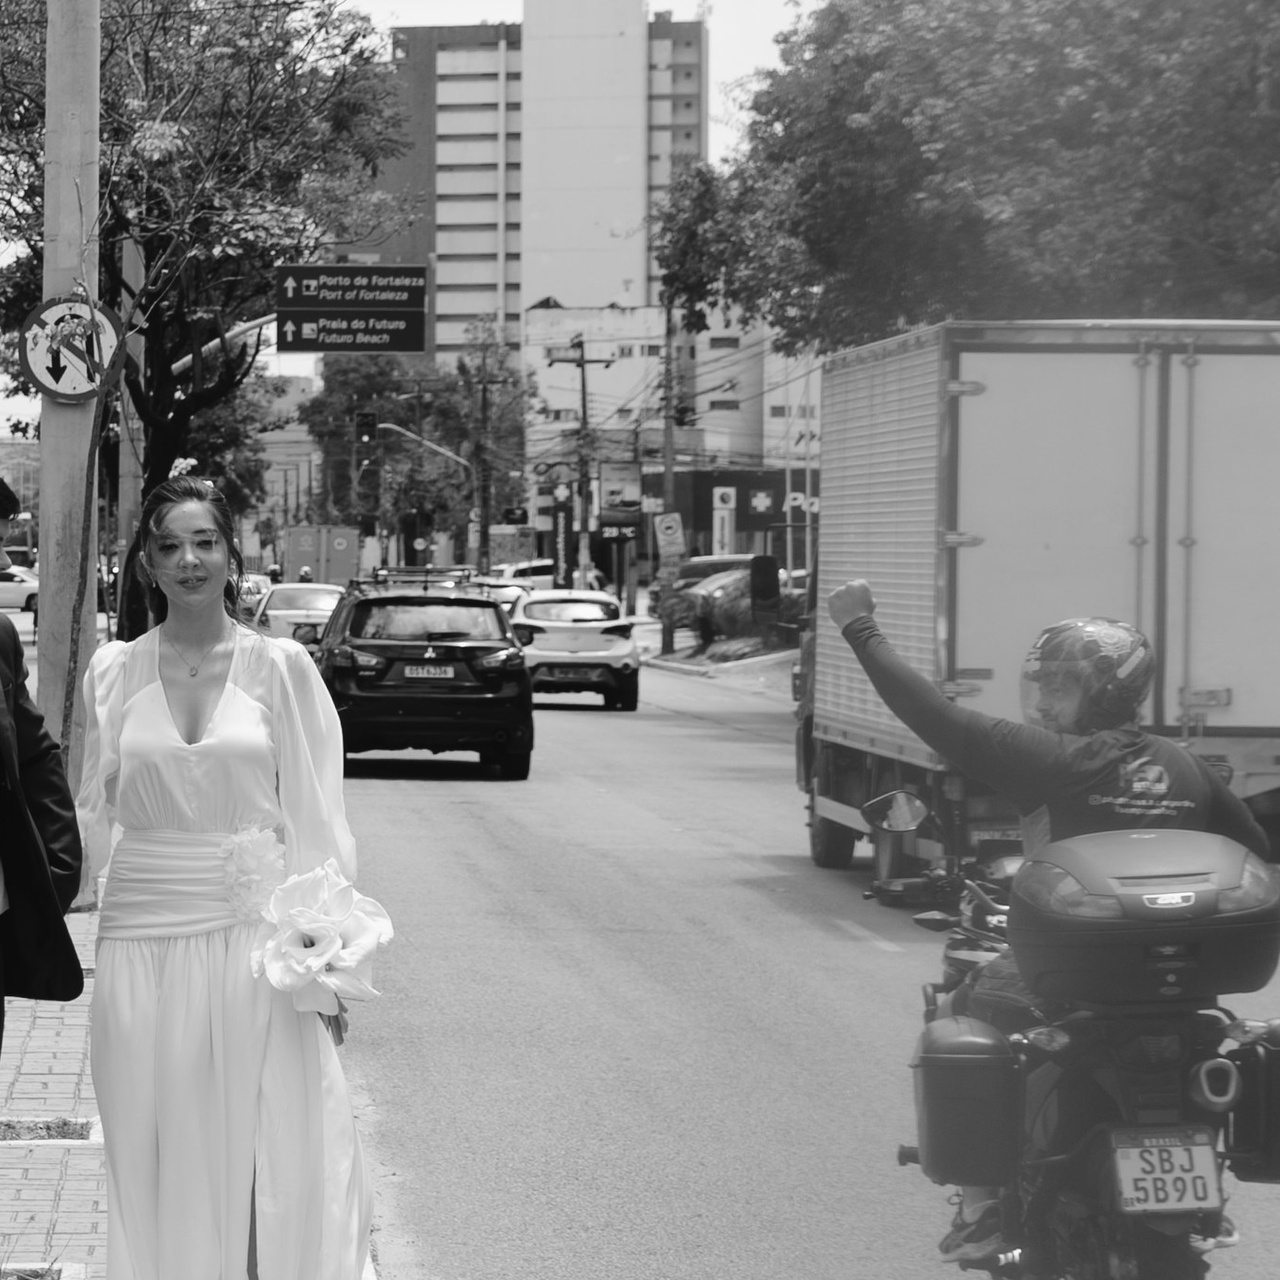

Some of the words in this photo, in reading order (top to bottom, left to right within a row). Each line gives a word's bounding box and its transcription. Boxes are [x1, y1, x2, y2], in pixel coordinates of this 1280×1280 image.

[319, 275, 351, 286] Porto
[353, 275, 369, 286] de
[371, 275, 425, 287] Fortaleza
[319, 289, 343, 300] Port
[344, 289, 357, 300] of
[358, 289, 409, 301] Fortaleza
[319, 318, 348, 329] Praia
[350, 318, 366, 329] do
[369, 318, 407, 330] Futuro
[318, 332, 354, 344] Futuro
[355, 332, 390, 344] Beach
[1143, 1137, 1182, 1147] BRASIL
[1139, 1147, 1194, 1175] SBJ
[1132, 1175, 1208, 1204] 5B90
